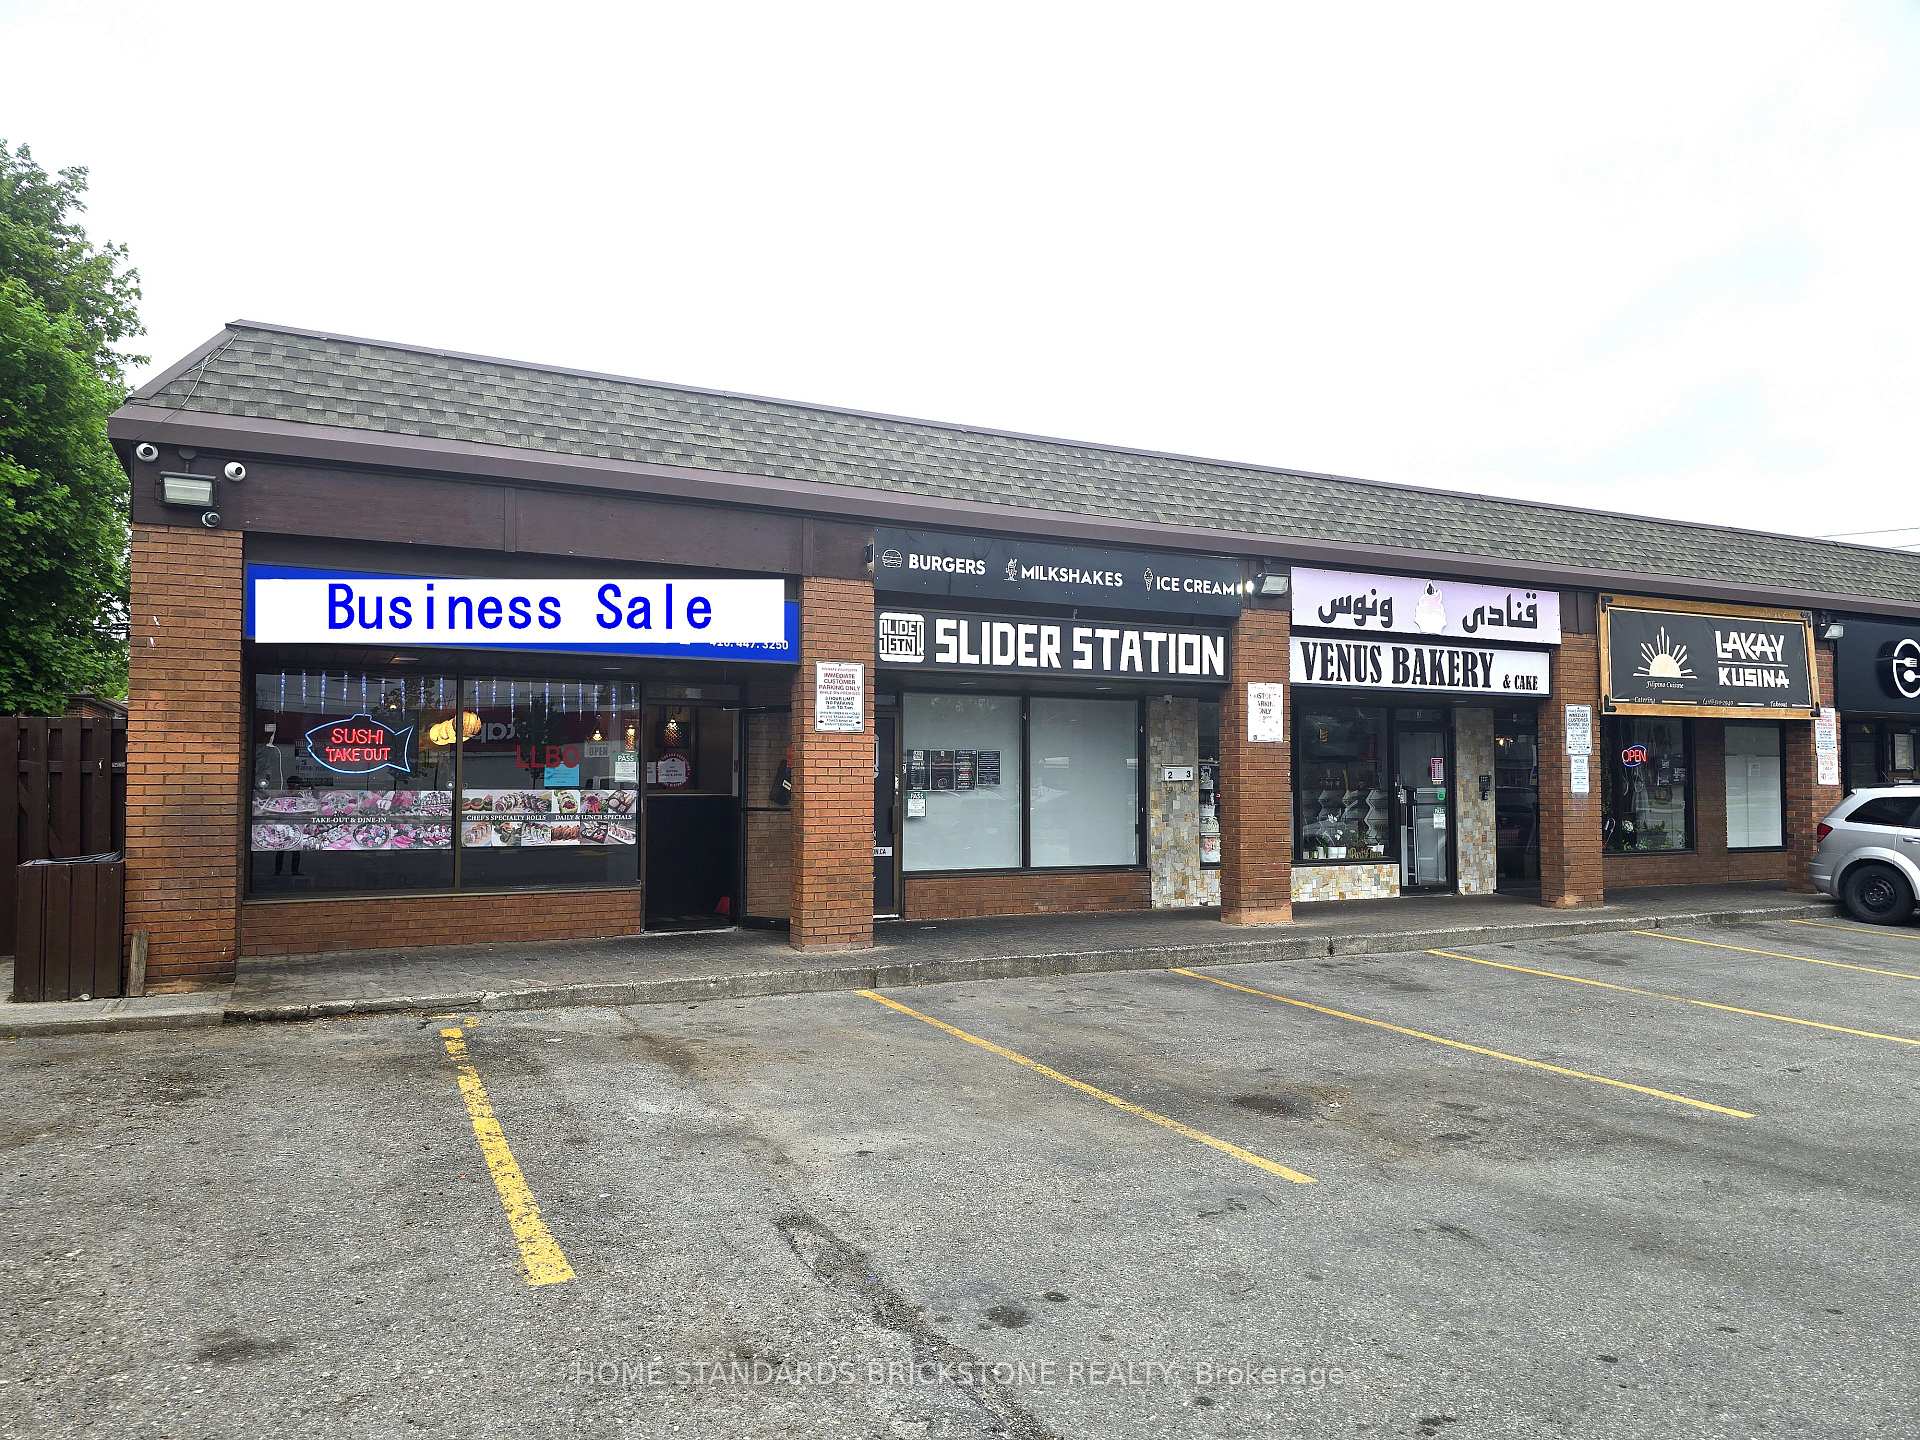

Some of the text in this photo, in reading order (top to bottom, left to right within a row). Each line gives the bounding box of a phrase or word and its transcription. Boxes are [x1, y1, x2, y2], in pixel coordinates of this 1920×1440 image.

[908, 553, 987, 576] BURGERS
[1021, 564, 1124, 588] MILKSHAKES
[1156, 575, 1236, 597] ICE CREAM
[1317, 588, 1394, 630] ونوس
[889, 637, 914, 654] STN
[934, 618, 1225, 676] SLIDER STATION
[1714, 630, 1785, 662] LAKAY
[1300, 641, 1539, 691] VENUS BAKERY & CAKE
[1718, 667, 1790, 689] KUSINA
[331, 728, 384, 745] SUSHI
[326, 747, 391, 762] TAKE OUT
[1621, 750, 1646, 762] OPEN
